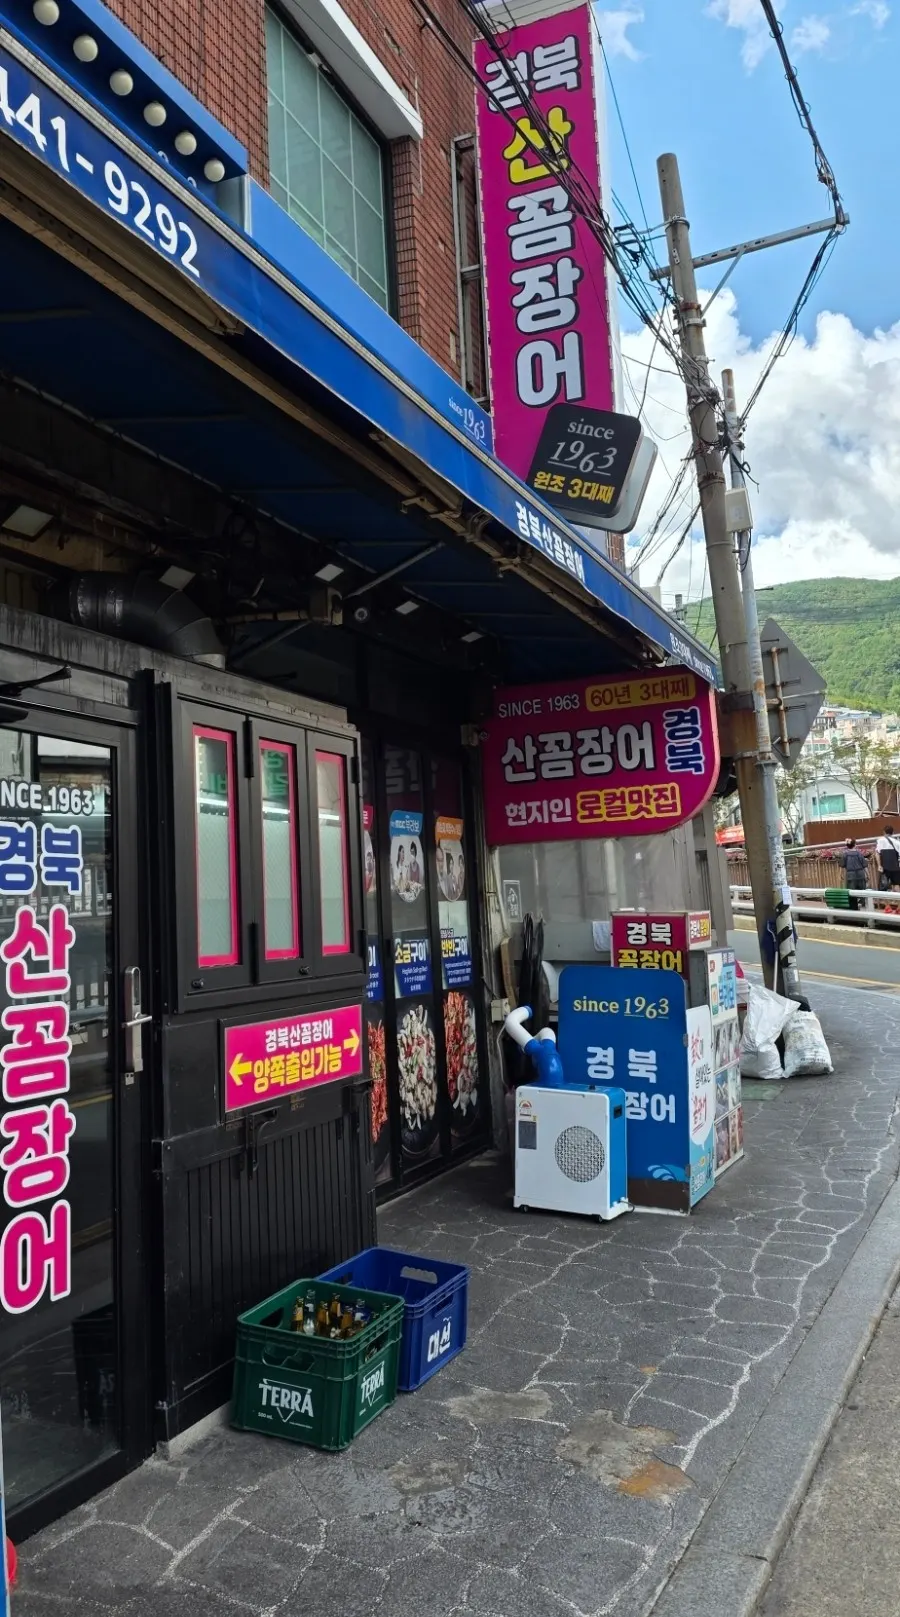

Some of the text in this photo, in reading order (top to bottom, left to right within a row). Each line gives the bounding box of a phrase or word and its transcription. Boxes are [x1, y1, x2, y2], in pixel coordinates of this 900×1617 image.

[484, 35, 582, 113] 경북
[502, 106, 585, 408] 산꼼장어
[464, 408, 485, 441] 1963
[567, 418, 615, 440] since
[550, 440, 618, 474] 1963
[533, 471, 616, 504] 원조 3대째
[515, 501, 586, 584] 경북산꼼장어
[498, 676, 691, 718] SINCE 1963 60년 3대째
[501, 721, 656, 783] 산꼼장어
[663, 706, 705, 775] 경북
[48, 785, 94, 816] 1963
[505, 783, 682, 826] 현지인 로컬맛집
[0, 821, 83, 896] 경북
[395, 942, 426, 964] 소금구이
[441, 937, 468, 958] 반반구이
[626, 922, 672, 946] 경북
[573, 996, 670, 1020] since 1963
[265, 1018, 333, 1053] 경북산꼼장어
[253, 1043, 343, 1094] 양쪽출입가능
[1, 904, 76, 1315] 산꼼장어
[258, 1380, 315, 1418] TERRA
[361, 1363, 385, 1404] TERRA
